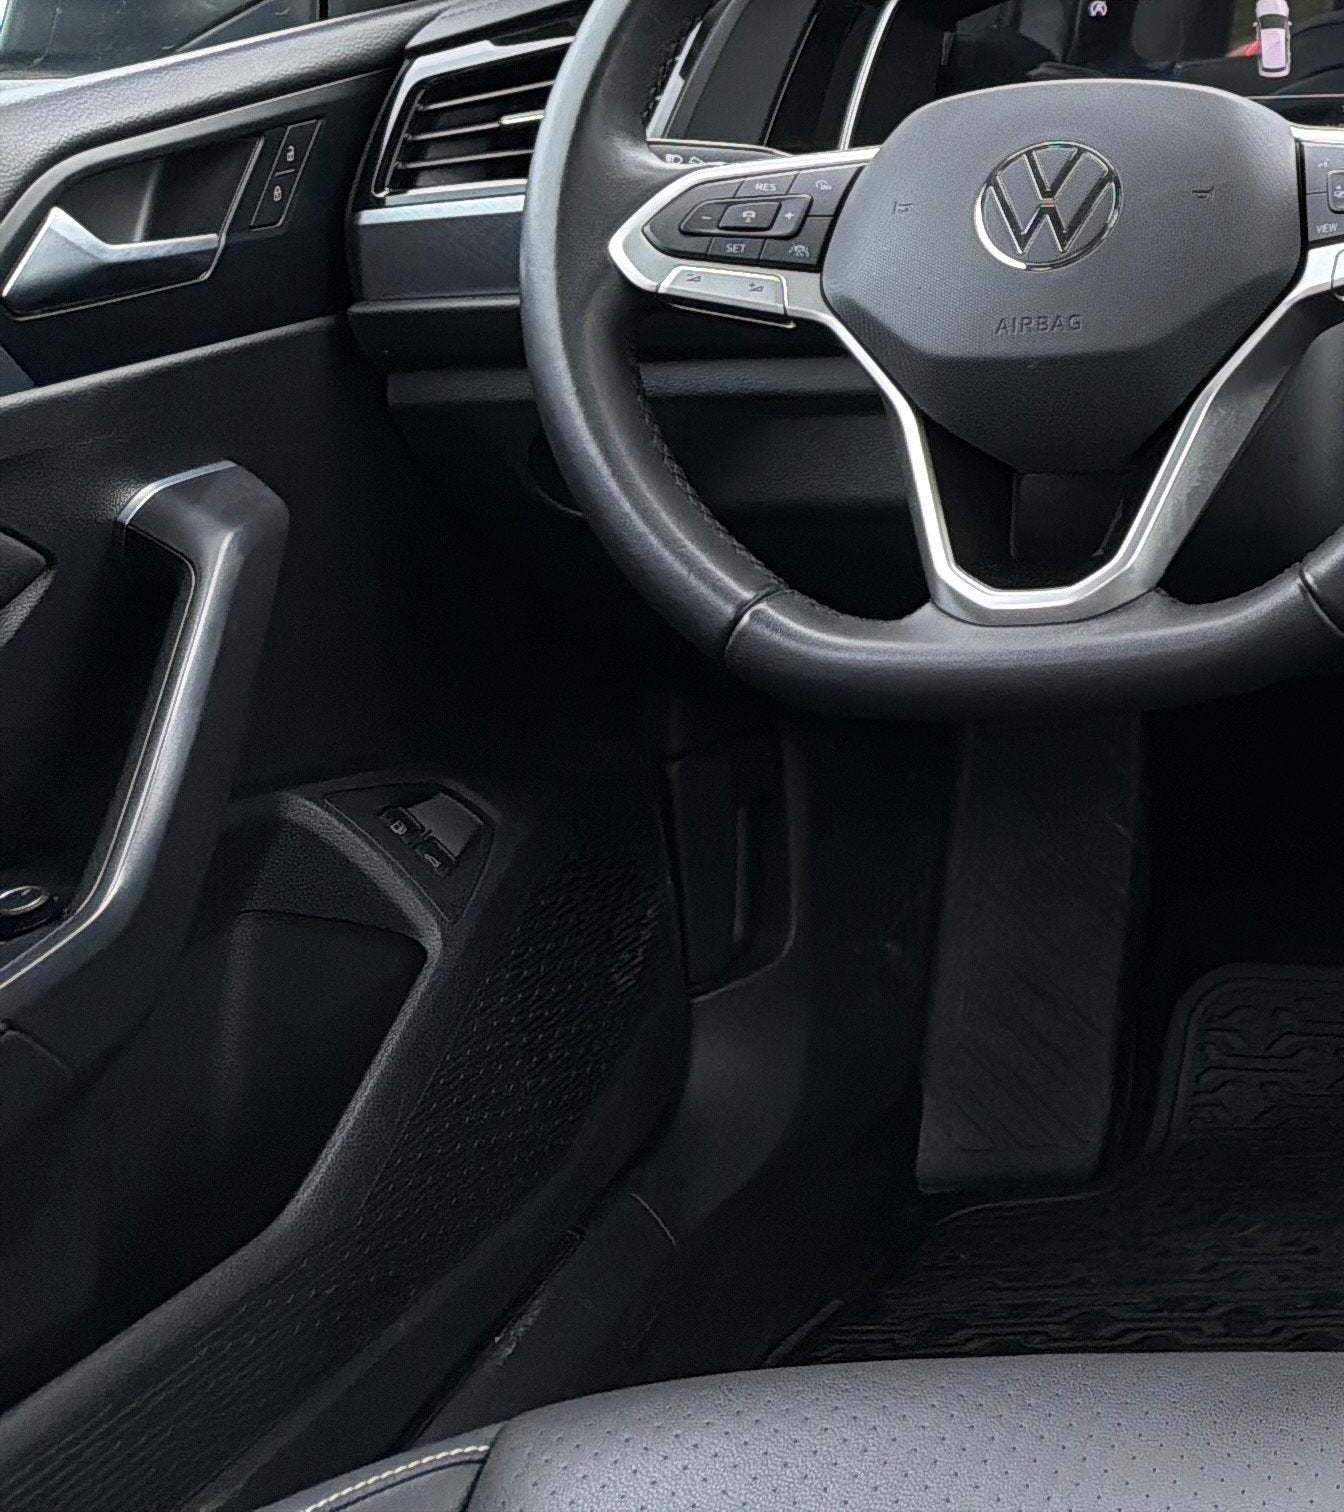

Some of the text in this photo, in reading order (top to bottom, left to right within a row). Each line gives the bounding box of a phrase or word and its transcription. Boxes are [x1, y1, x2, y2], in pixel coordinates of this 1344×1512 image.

[755, 183, 777, 192] RES
[980, 144, 1119, 264] VW
[1316, 223, 1337, 234] VIEW
[726, 243, 747, 253] SET
[995, 314, 1081, 335] AIRBAG
